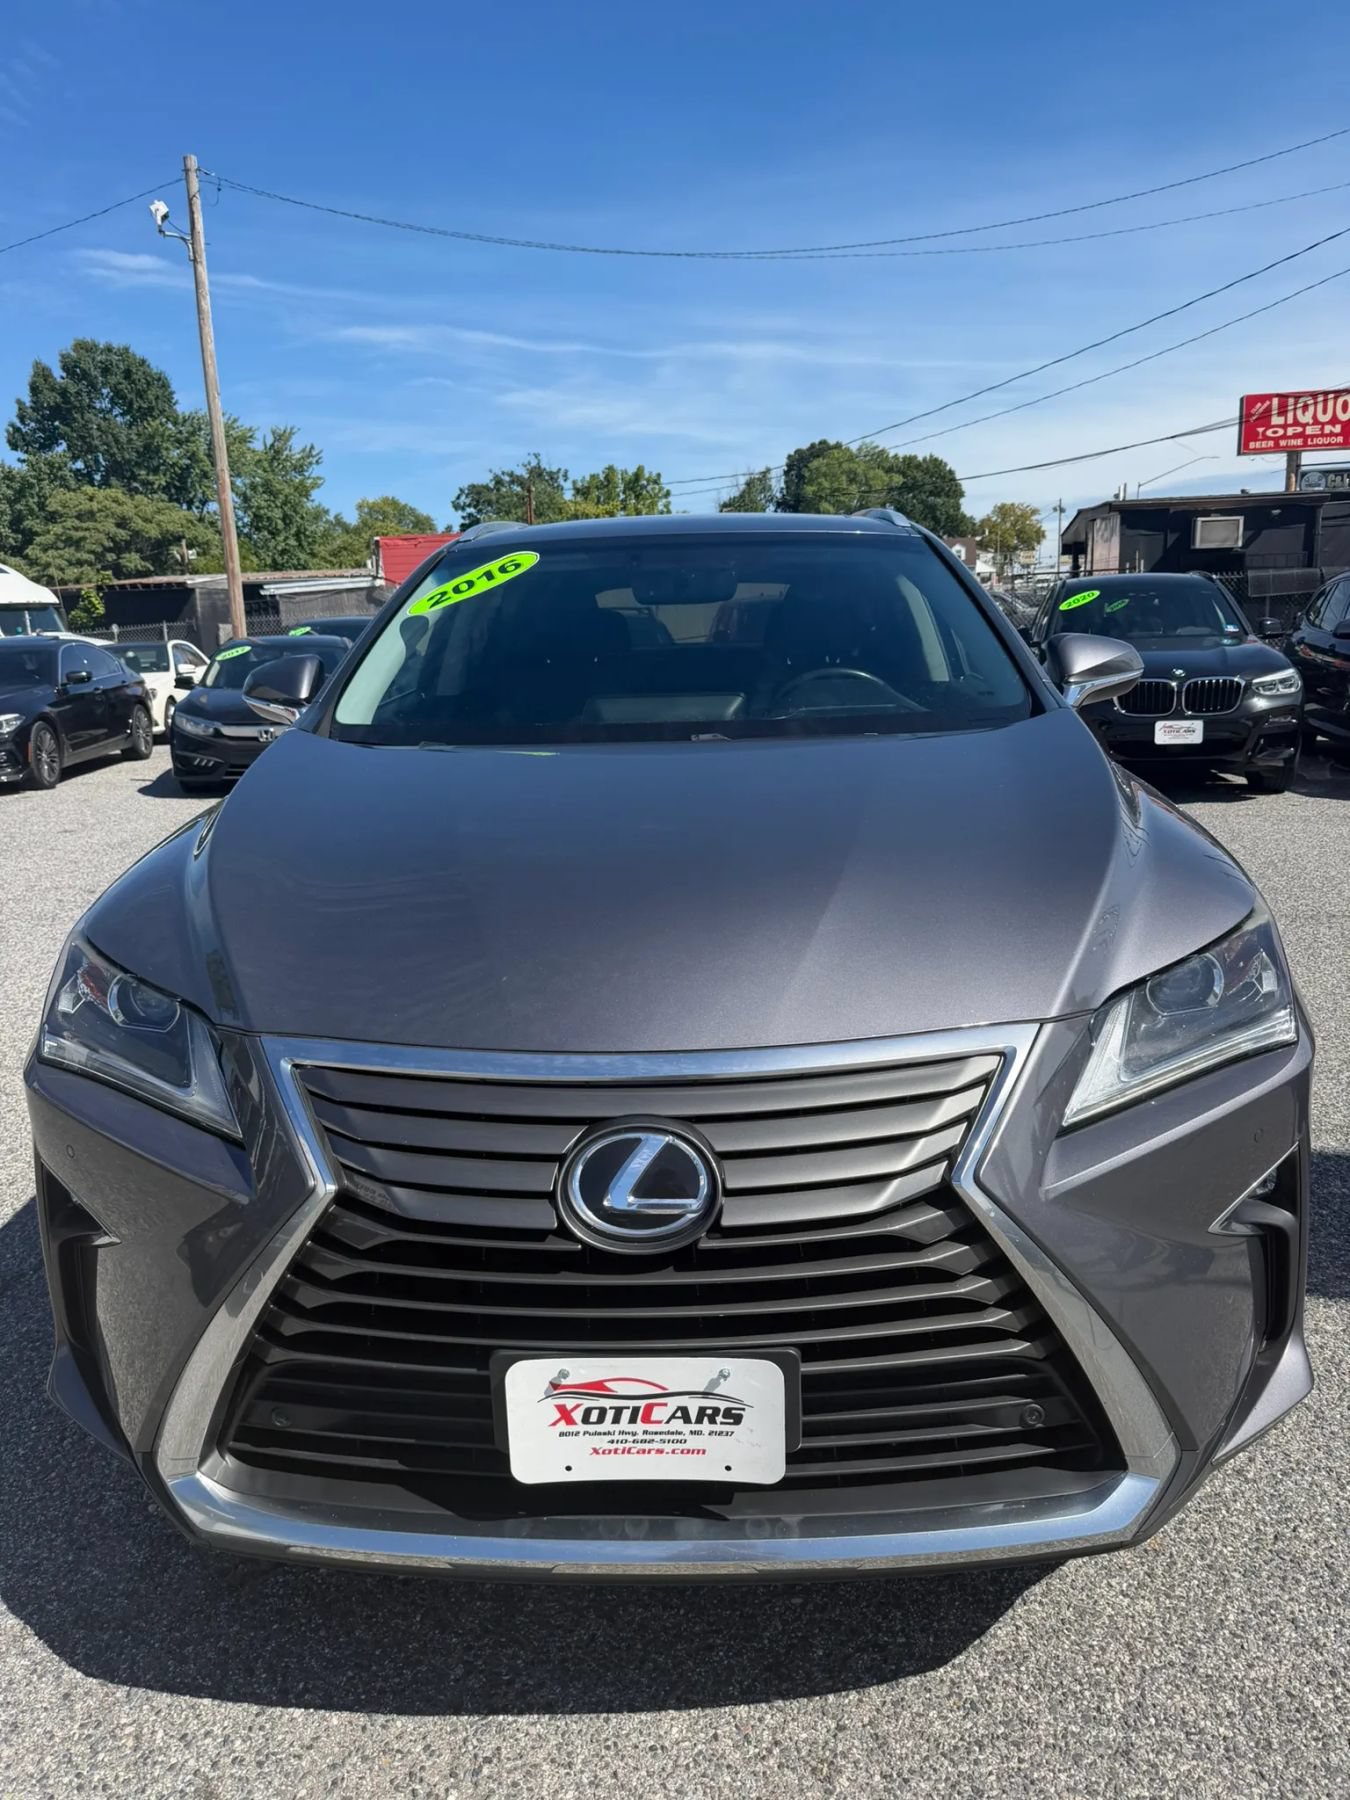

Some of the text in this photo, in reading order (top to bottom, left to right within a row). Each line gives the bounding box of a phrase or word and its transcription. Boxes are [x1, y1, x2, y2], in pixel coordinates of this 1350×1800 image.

[1265, 424, 1342, 437] OPEN
[1249, 436, 1344, 449] BEER WINE LIQUOR
[426, 559, 523, 610] 2016
[1064, 592, 1095, 608] 2020
[558, 1430, 581, 1438] 8012
[582, 1429, 616, 1437] Pulaski
[618, 1429, 639, 1437] Hwy.
[642, 1429, 686, 1437] Rosedale,
[589, 1446, 707, 1456] XotiCars.com
